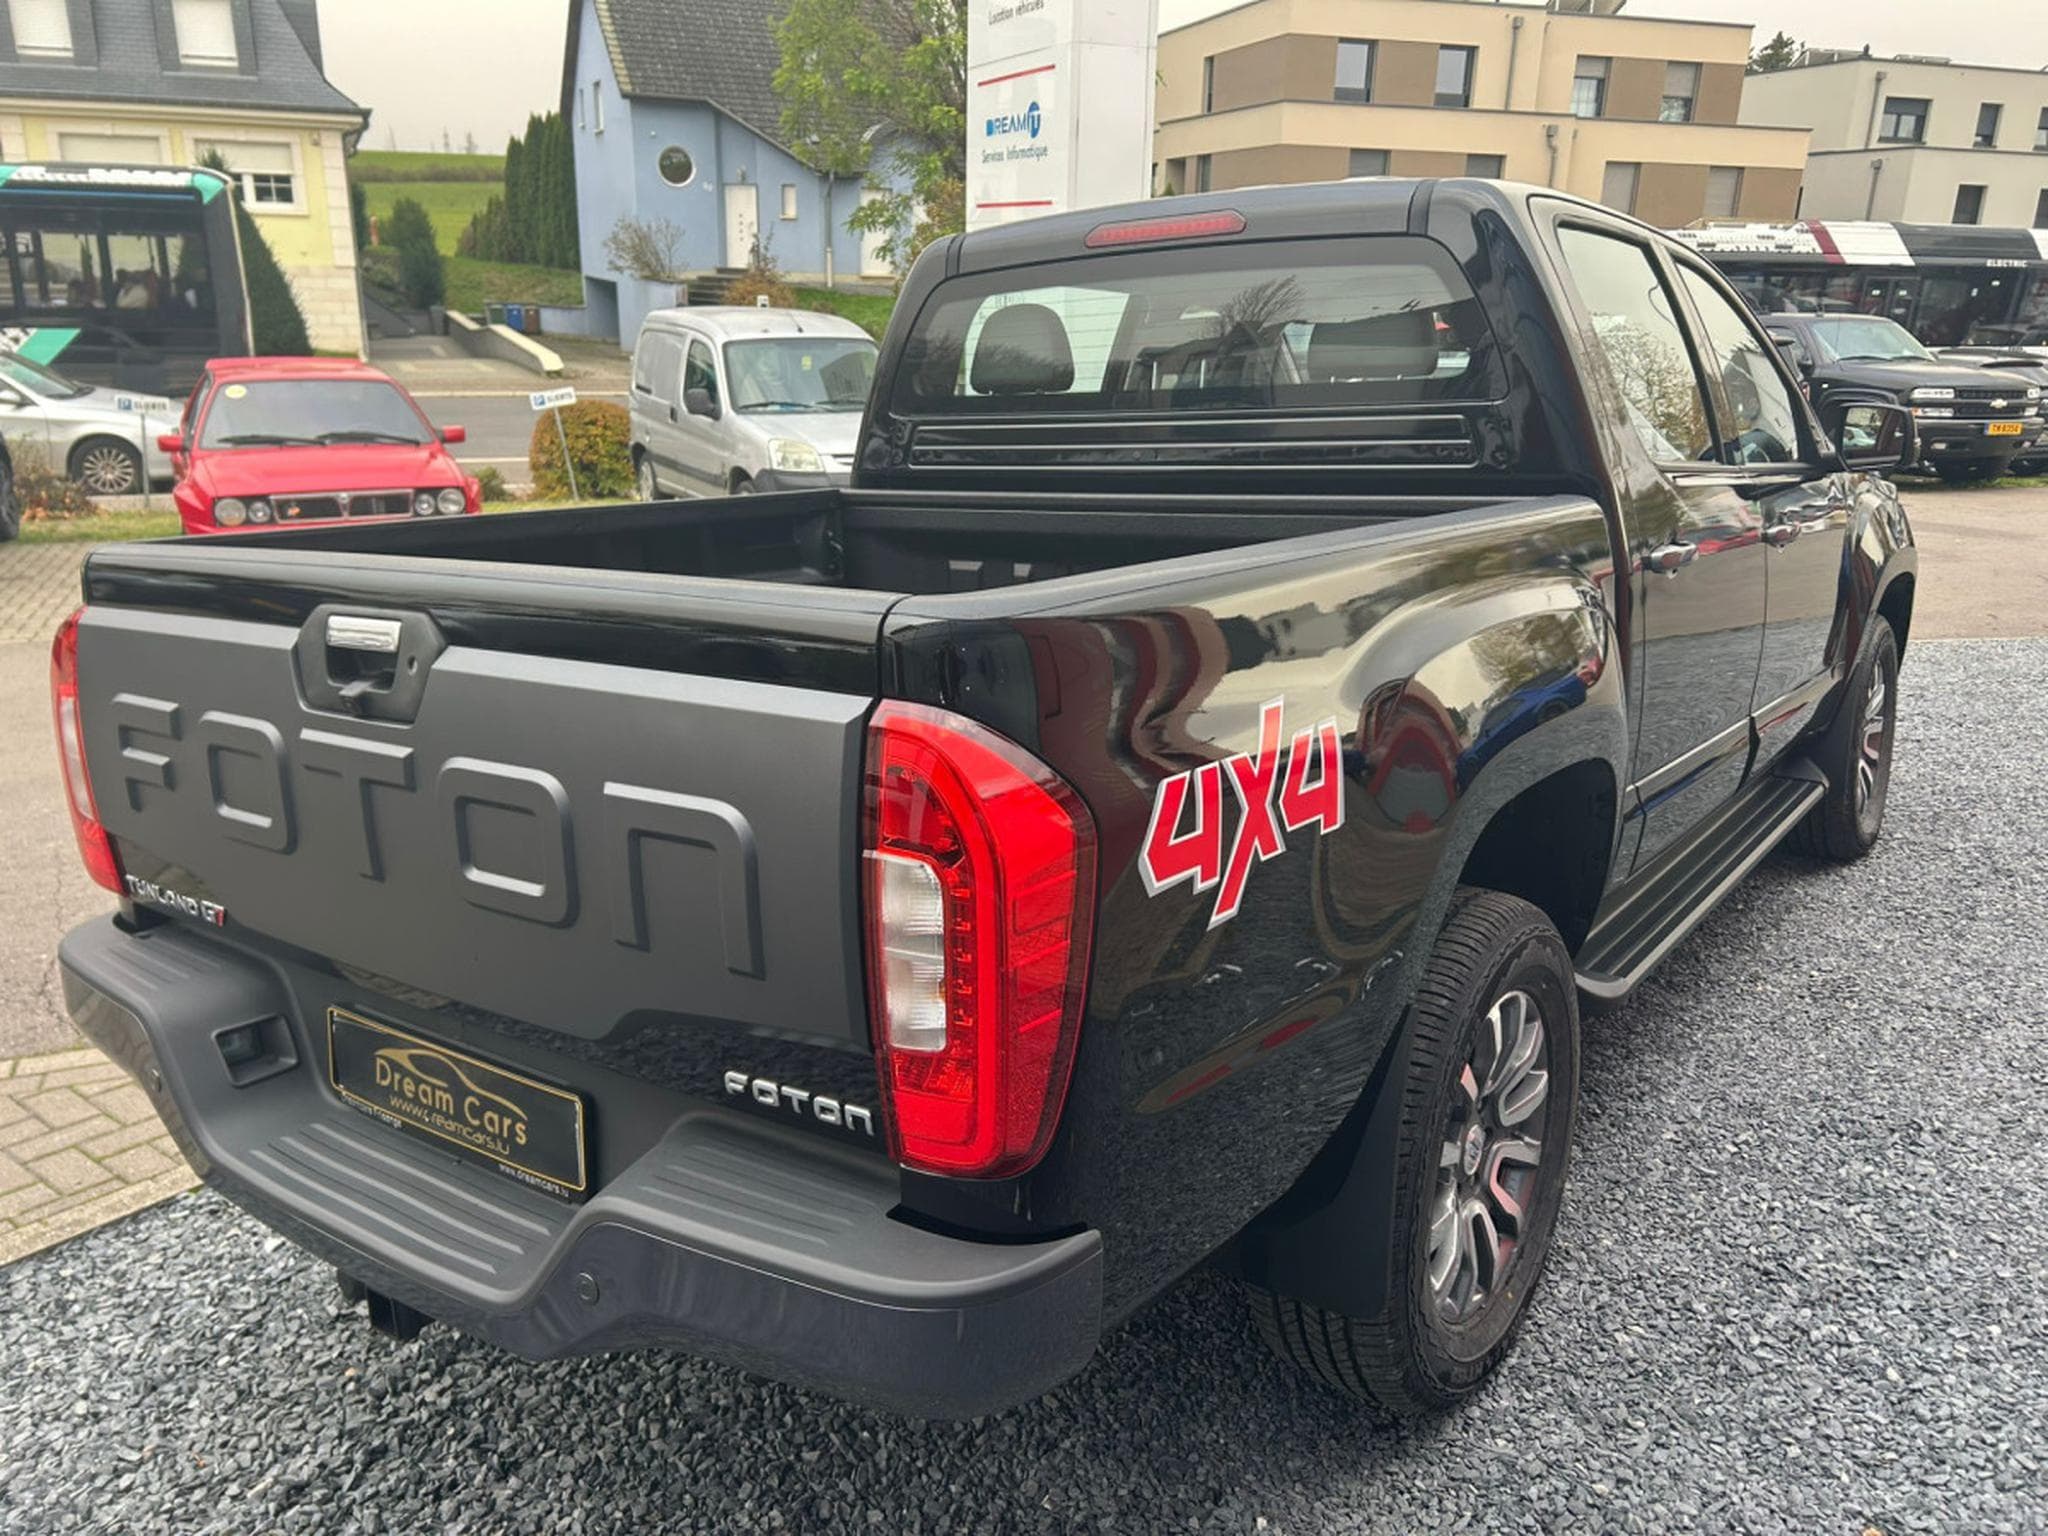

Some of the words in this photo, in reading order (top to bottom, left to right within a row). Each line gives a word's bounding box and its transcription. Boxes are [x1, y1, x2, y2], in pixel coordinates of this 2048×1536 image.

[988, 7, 1014, 25] Location
[1986, 259, 2028, 267] ELECTRIC
[375, 1056, 454, 1115] Dream
[463, 1095, 529, 1147] Cars
